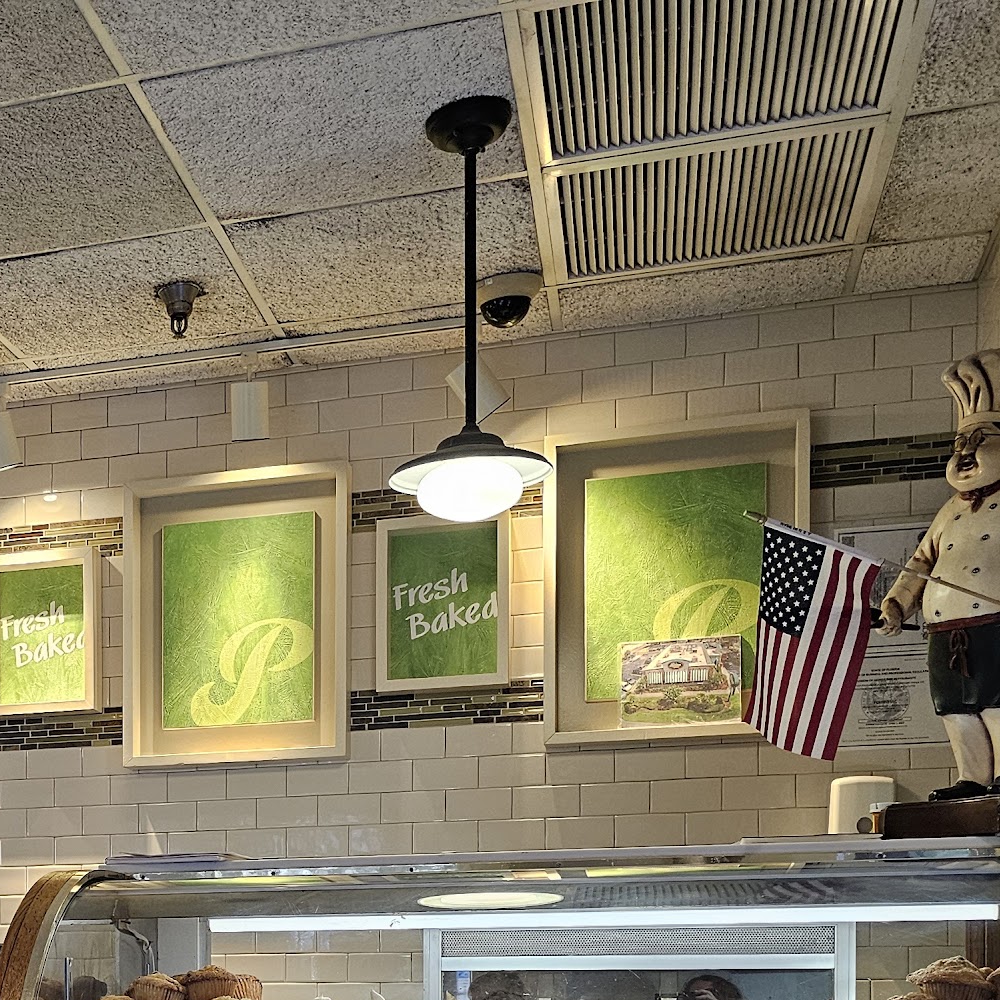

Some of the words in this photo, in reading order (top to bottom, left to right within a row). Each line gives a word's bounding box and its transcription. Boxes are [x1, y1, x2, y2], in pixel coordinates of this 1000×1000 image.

[392, 567, 468, 611] Fresh
[0, 600, 65, 641] Fresh
[405, 591, 498, 640] Baked
[191, 617, 314, 726] P
